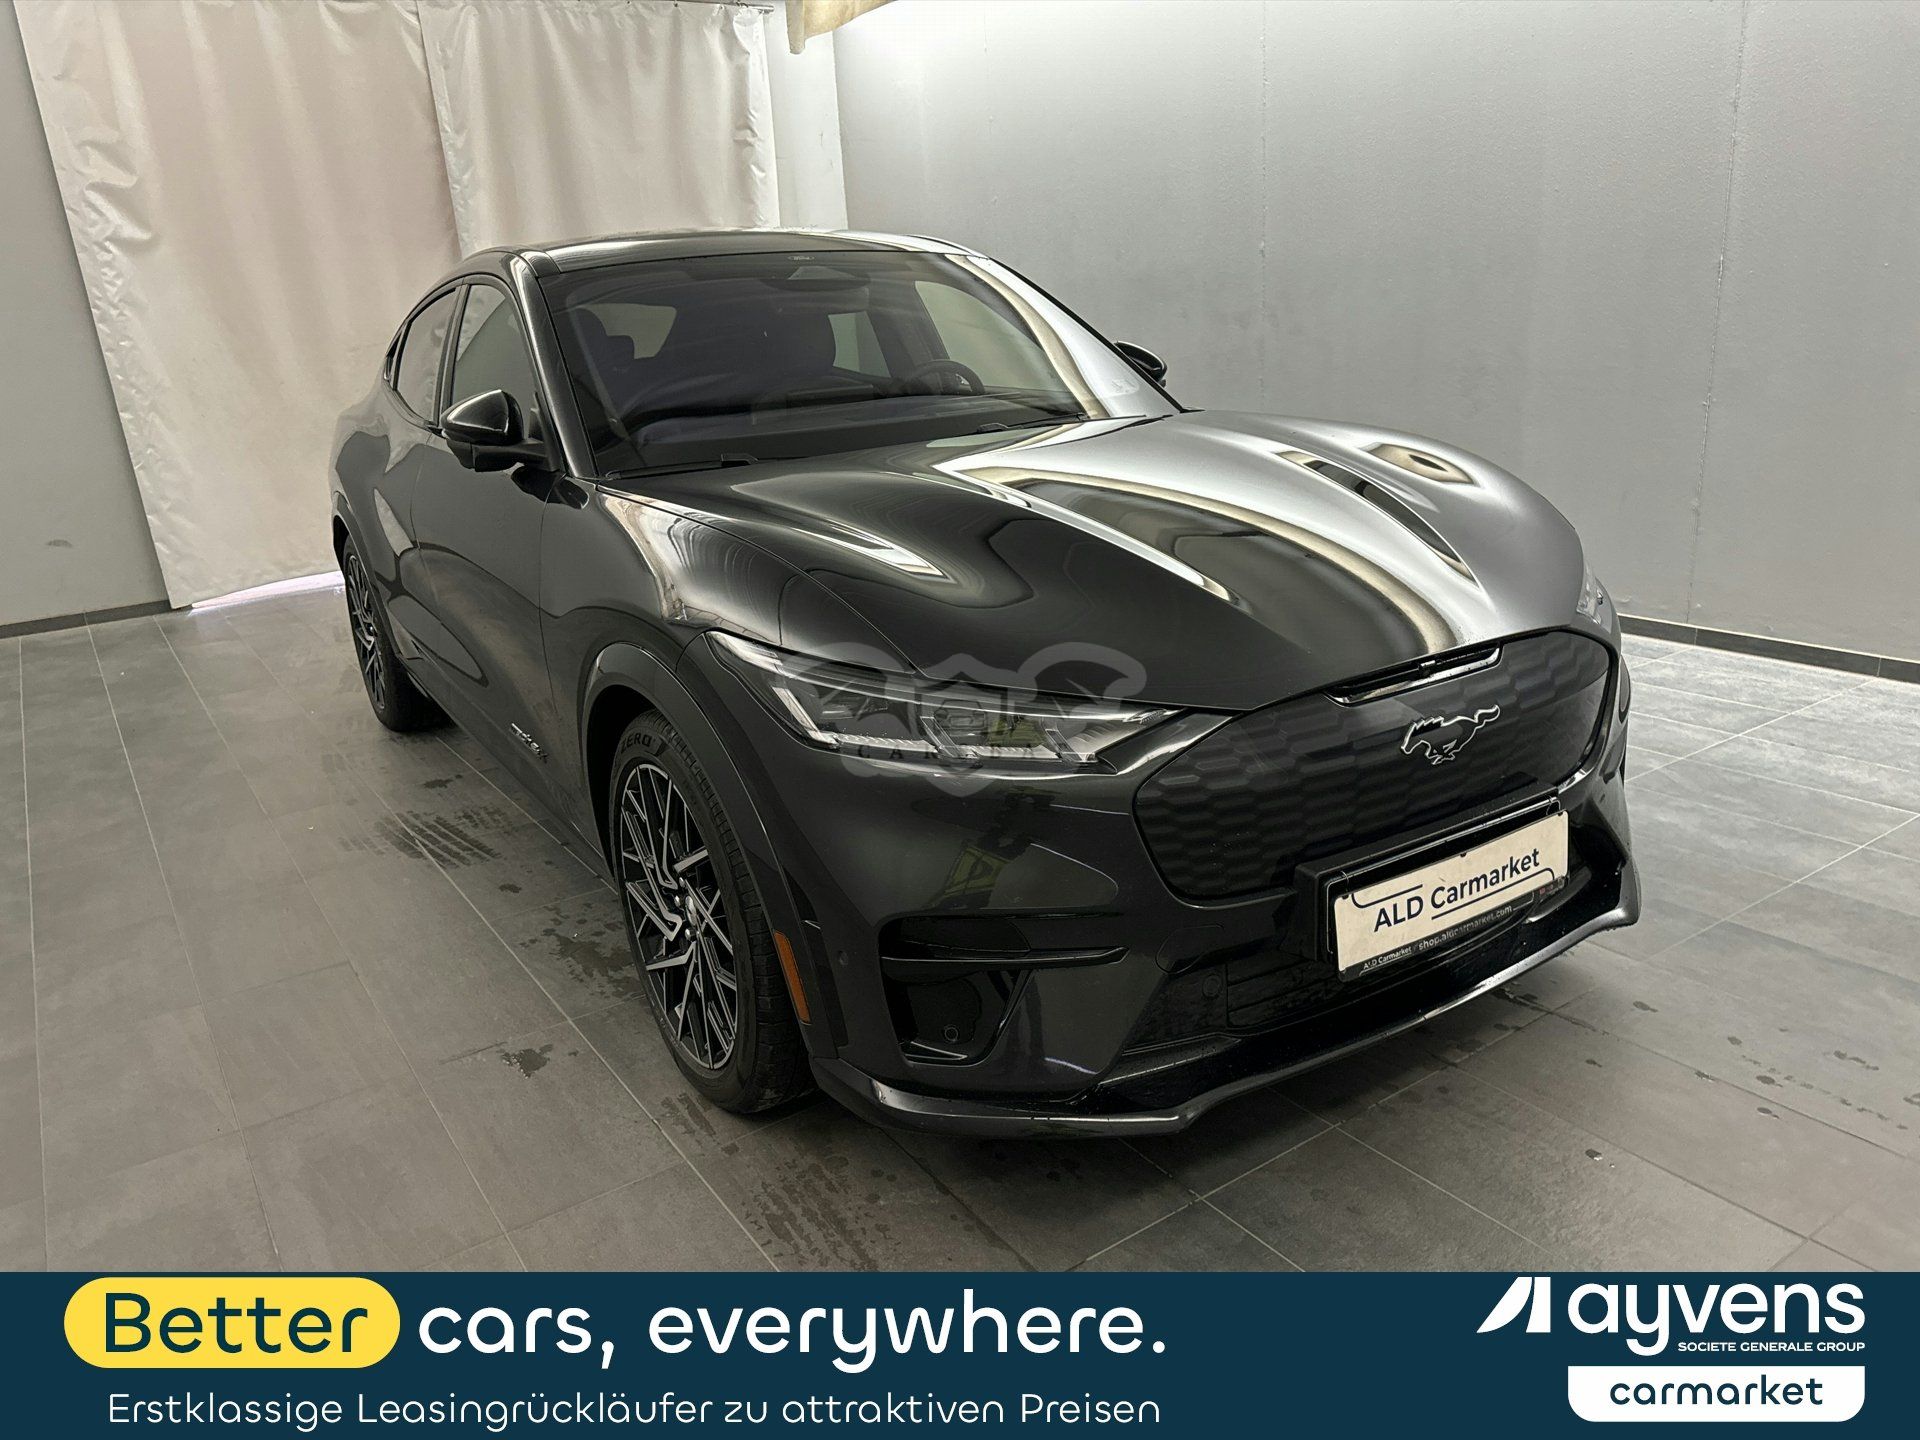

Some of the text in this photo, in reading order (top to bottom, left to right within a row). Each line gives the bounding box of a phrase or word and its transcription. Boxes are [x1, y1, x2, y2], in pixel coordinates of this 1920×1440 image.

[1374, 848, 1540, 932] ALD Carmarket
[1378, 946, 1412, 965] Carmarket
